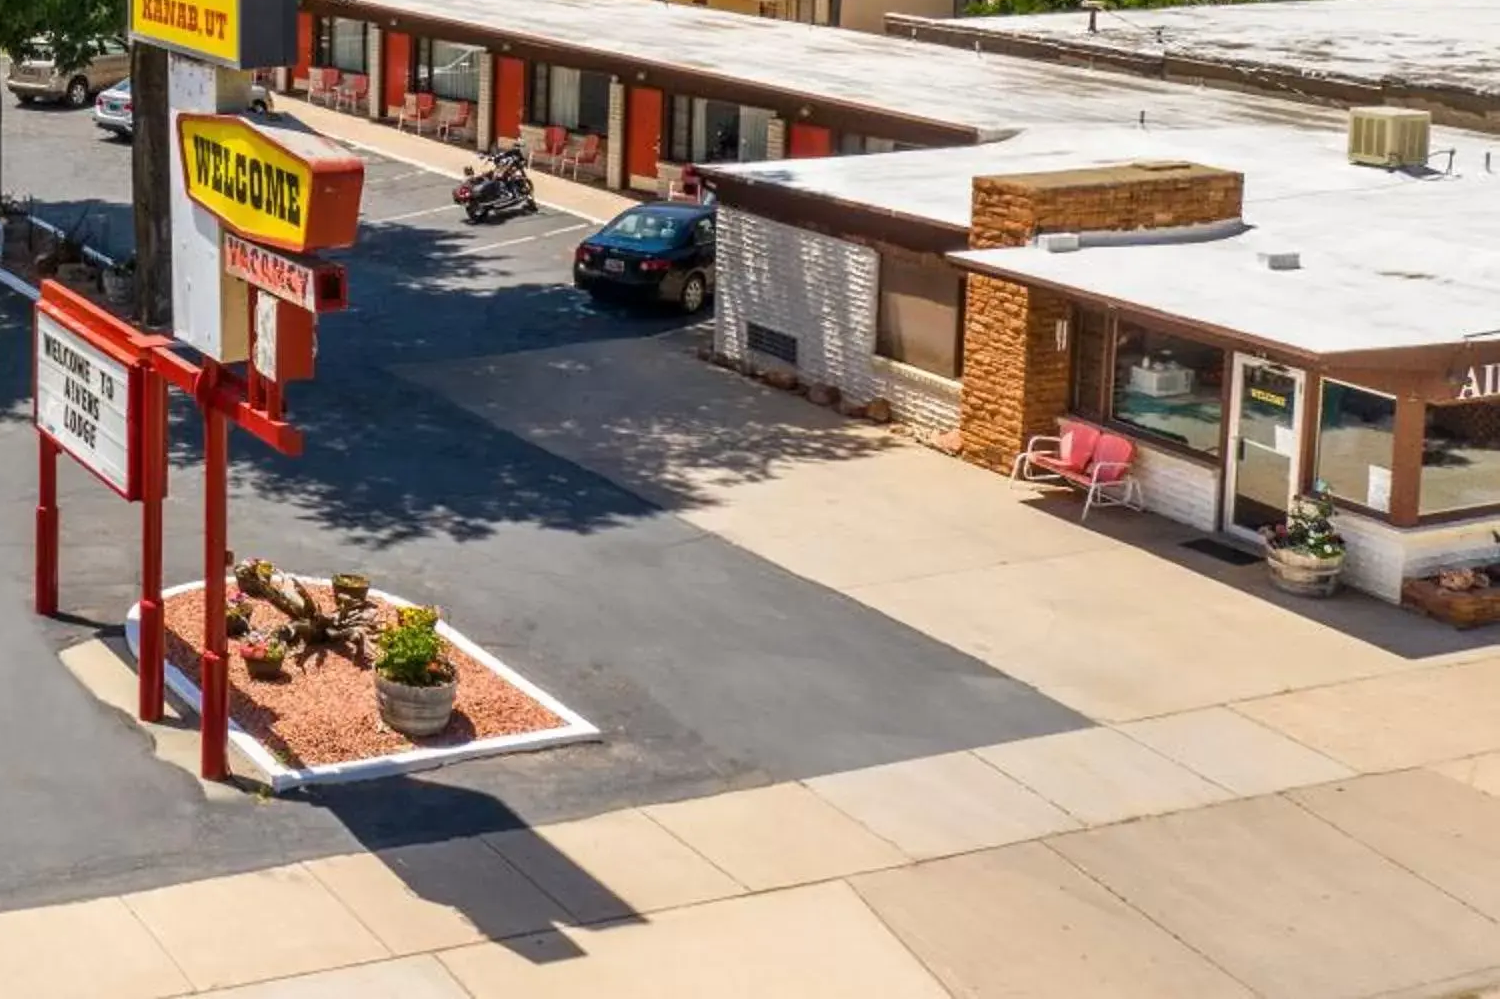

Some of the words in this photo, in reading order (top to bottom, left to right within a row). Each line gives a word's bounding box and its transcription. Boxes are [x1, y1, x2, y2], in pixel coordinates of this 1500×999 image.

[204, 8, 228, 40] UT
[193, 134, 300, 227] WELCOME
[43, 332, 91, 384] WELCOME
[99, 370, 114, 401] TO
[1456, 363, 1500, 400] AI
[63, 374, 100, 422] AIKENS
[63, 408, 97, 449] LODGE
